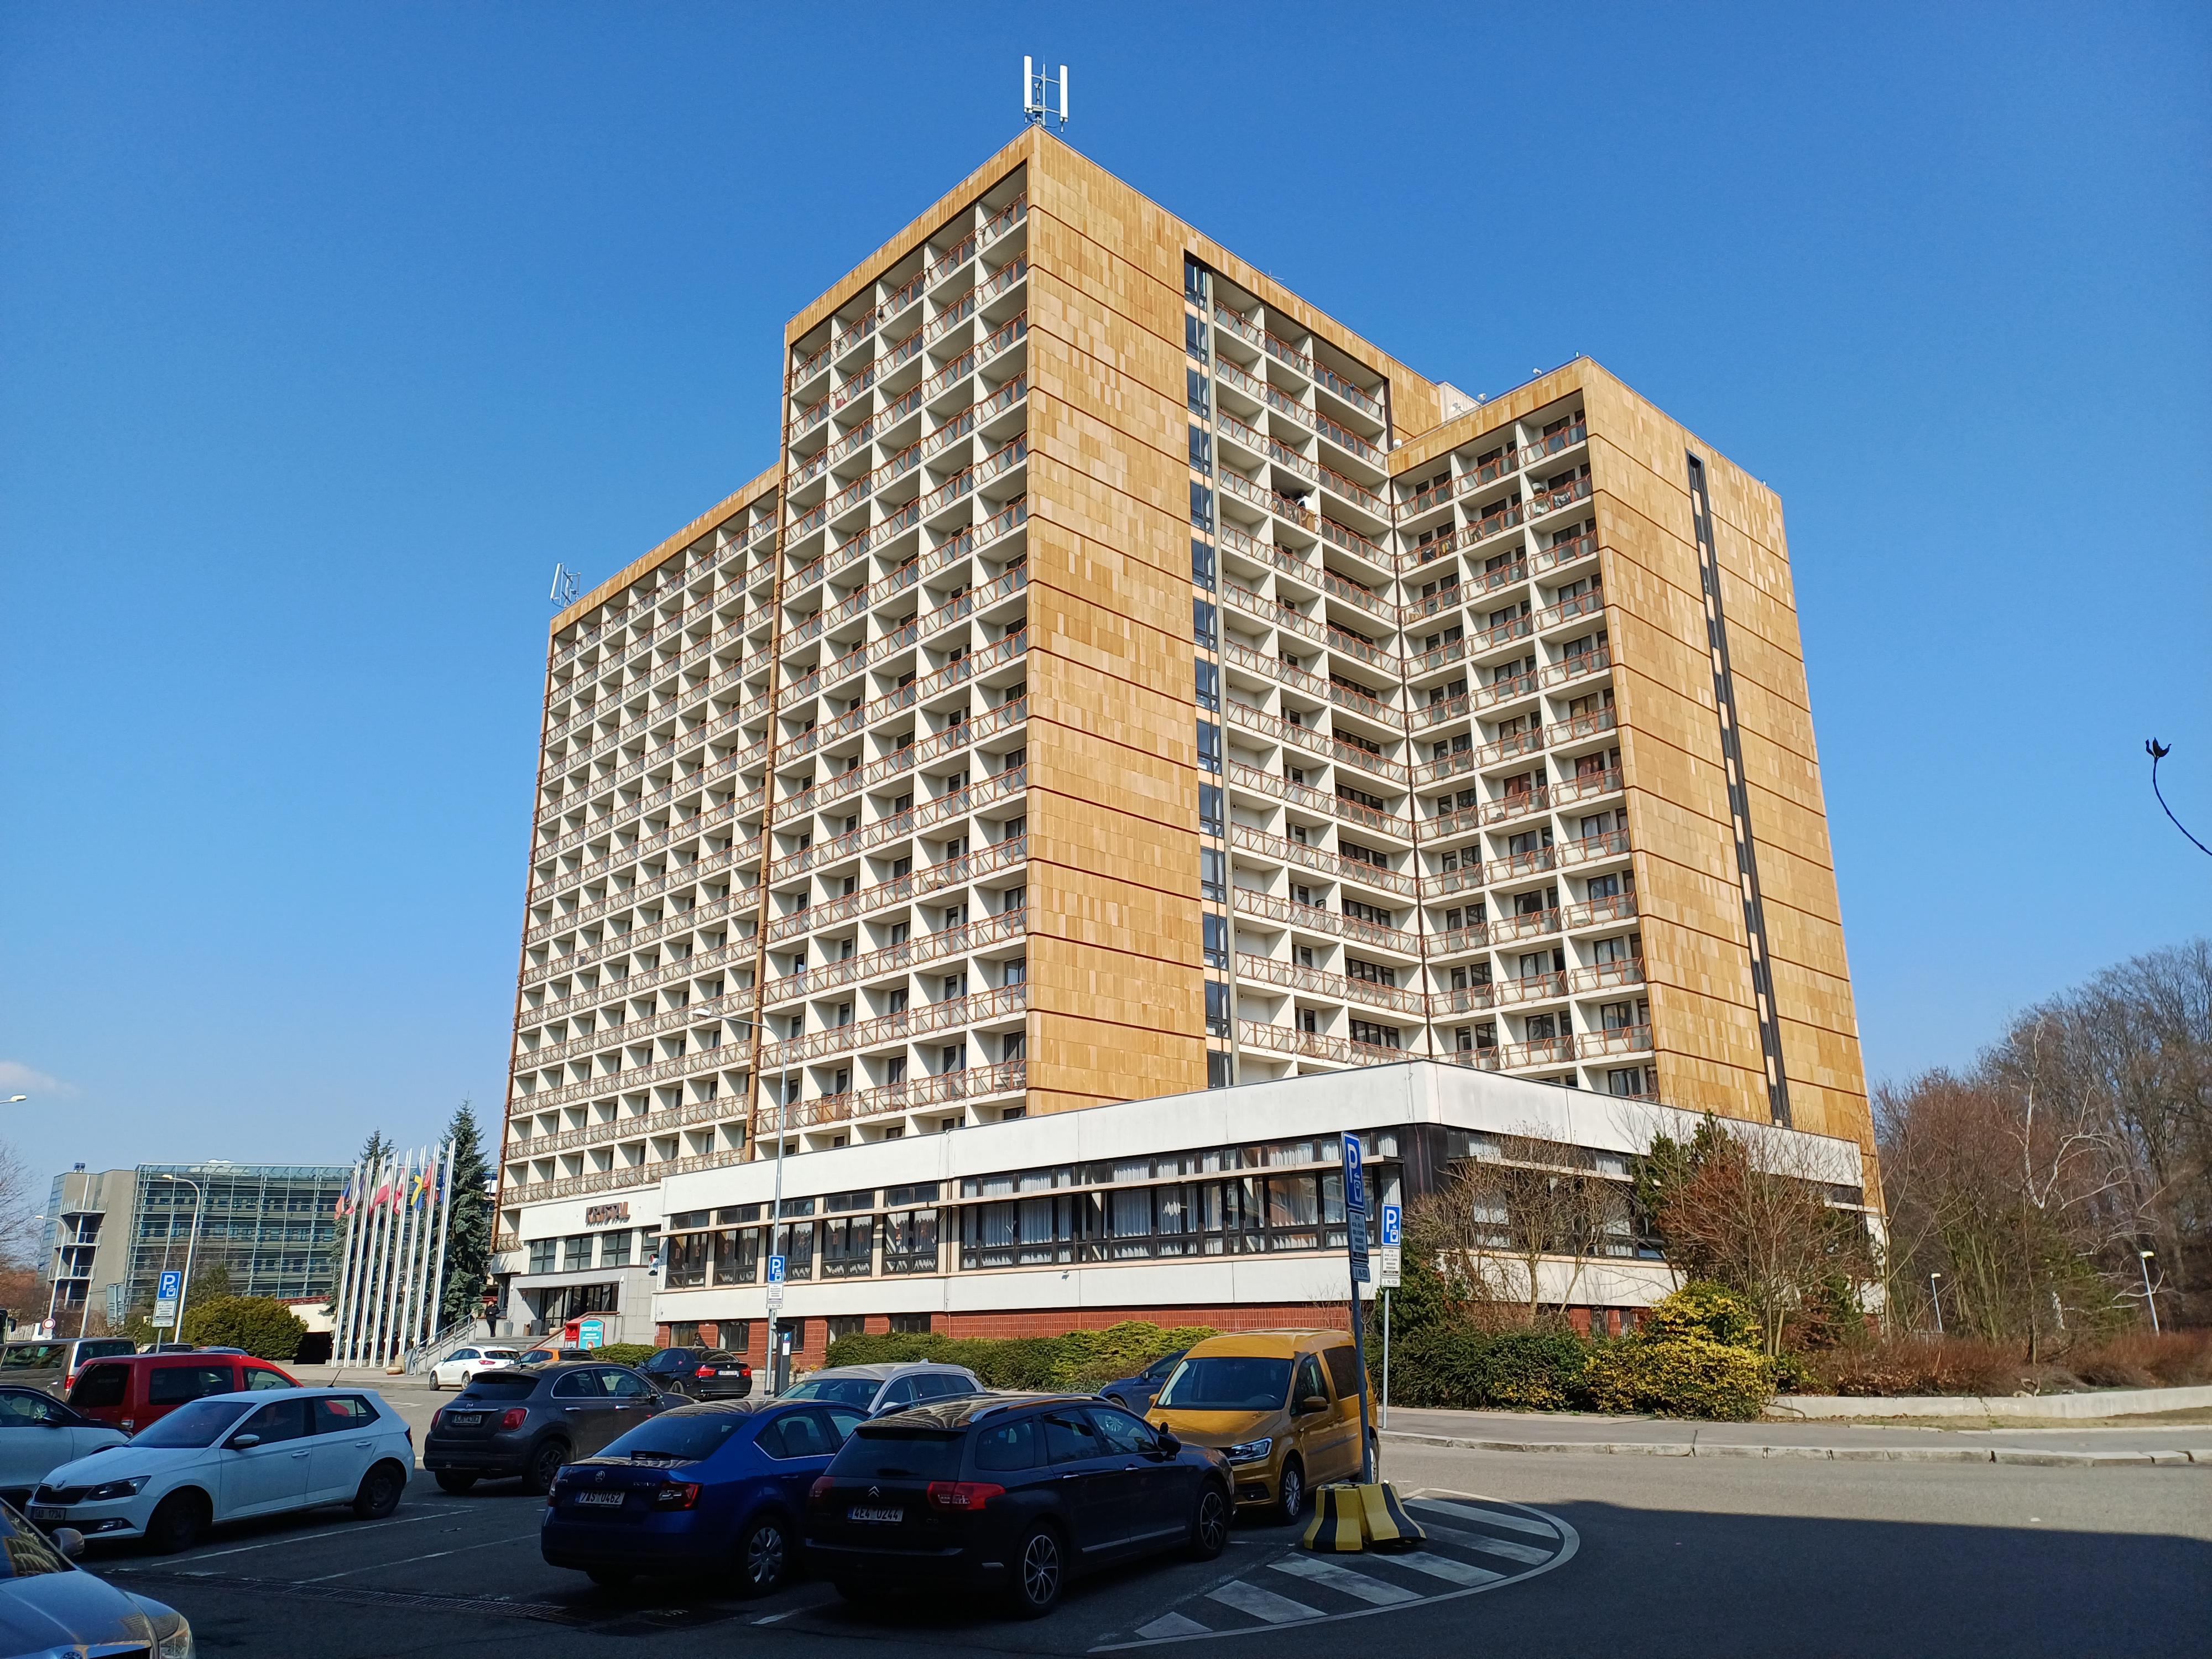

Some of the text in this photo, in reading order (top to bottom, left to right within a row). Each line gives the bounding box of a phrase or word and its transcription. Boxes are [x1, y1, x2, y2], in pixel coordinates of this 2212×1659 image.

[1348, 1143, 1358, 1183] P
[1386, 1209, 1397, 1233] P
[772, 1259, 781, 1274] P
[162, 1275, 175, 1291] P
[601, 1492, 620, 1504] 0462
[854, 1506, 899, 1520] 4E4 0244
